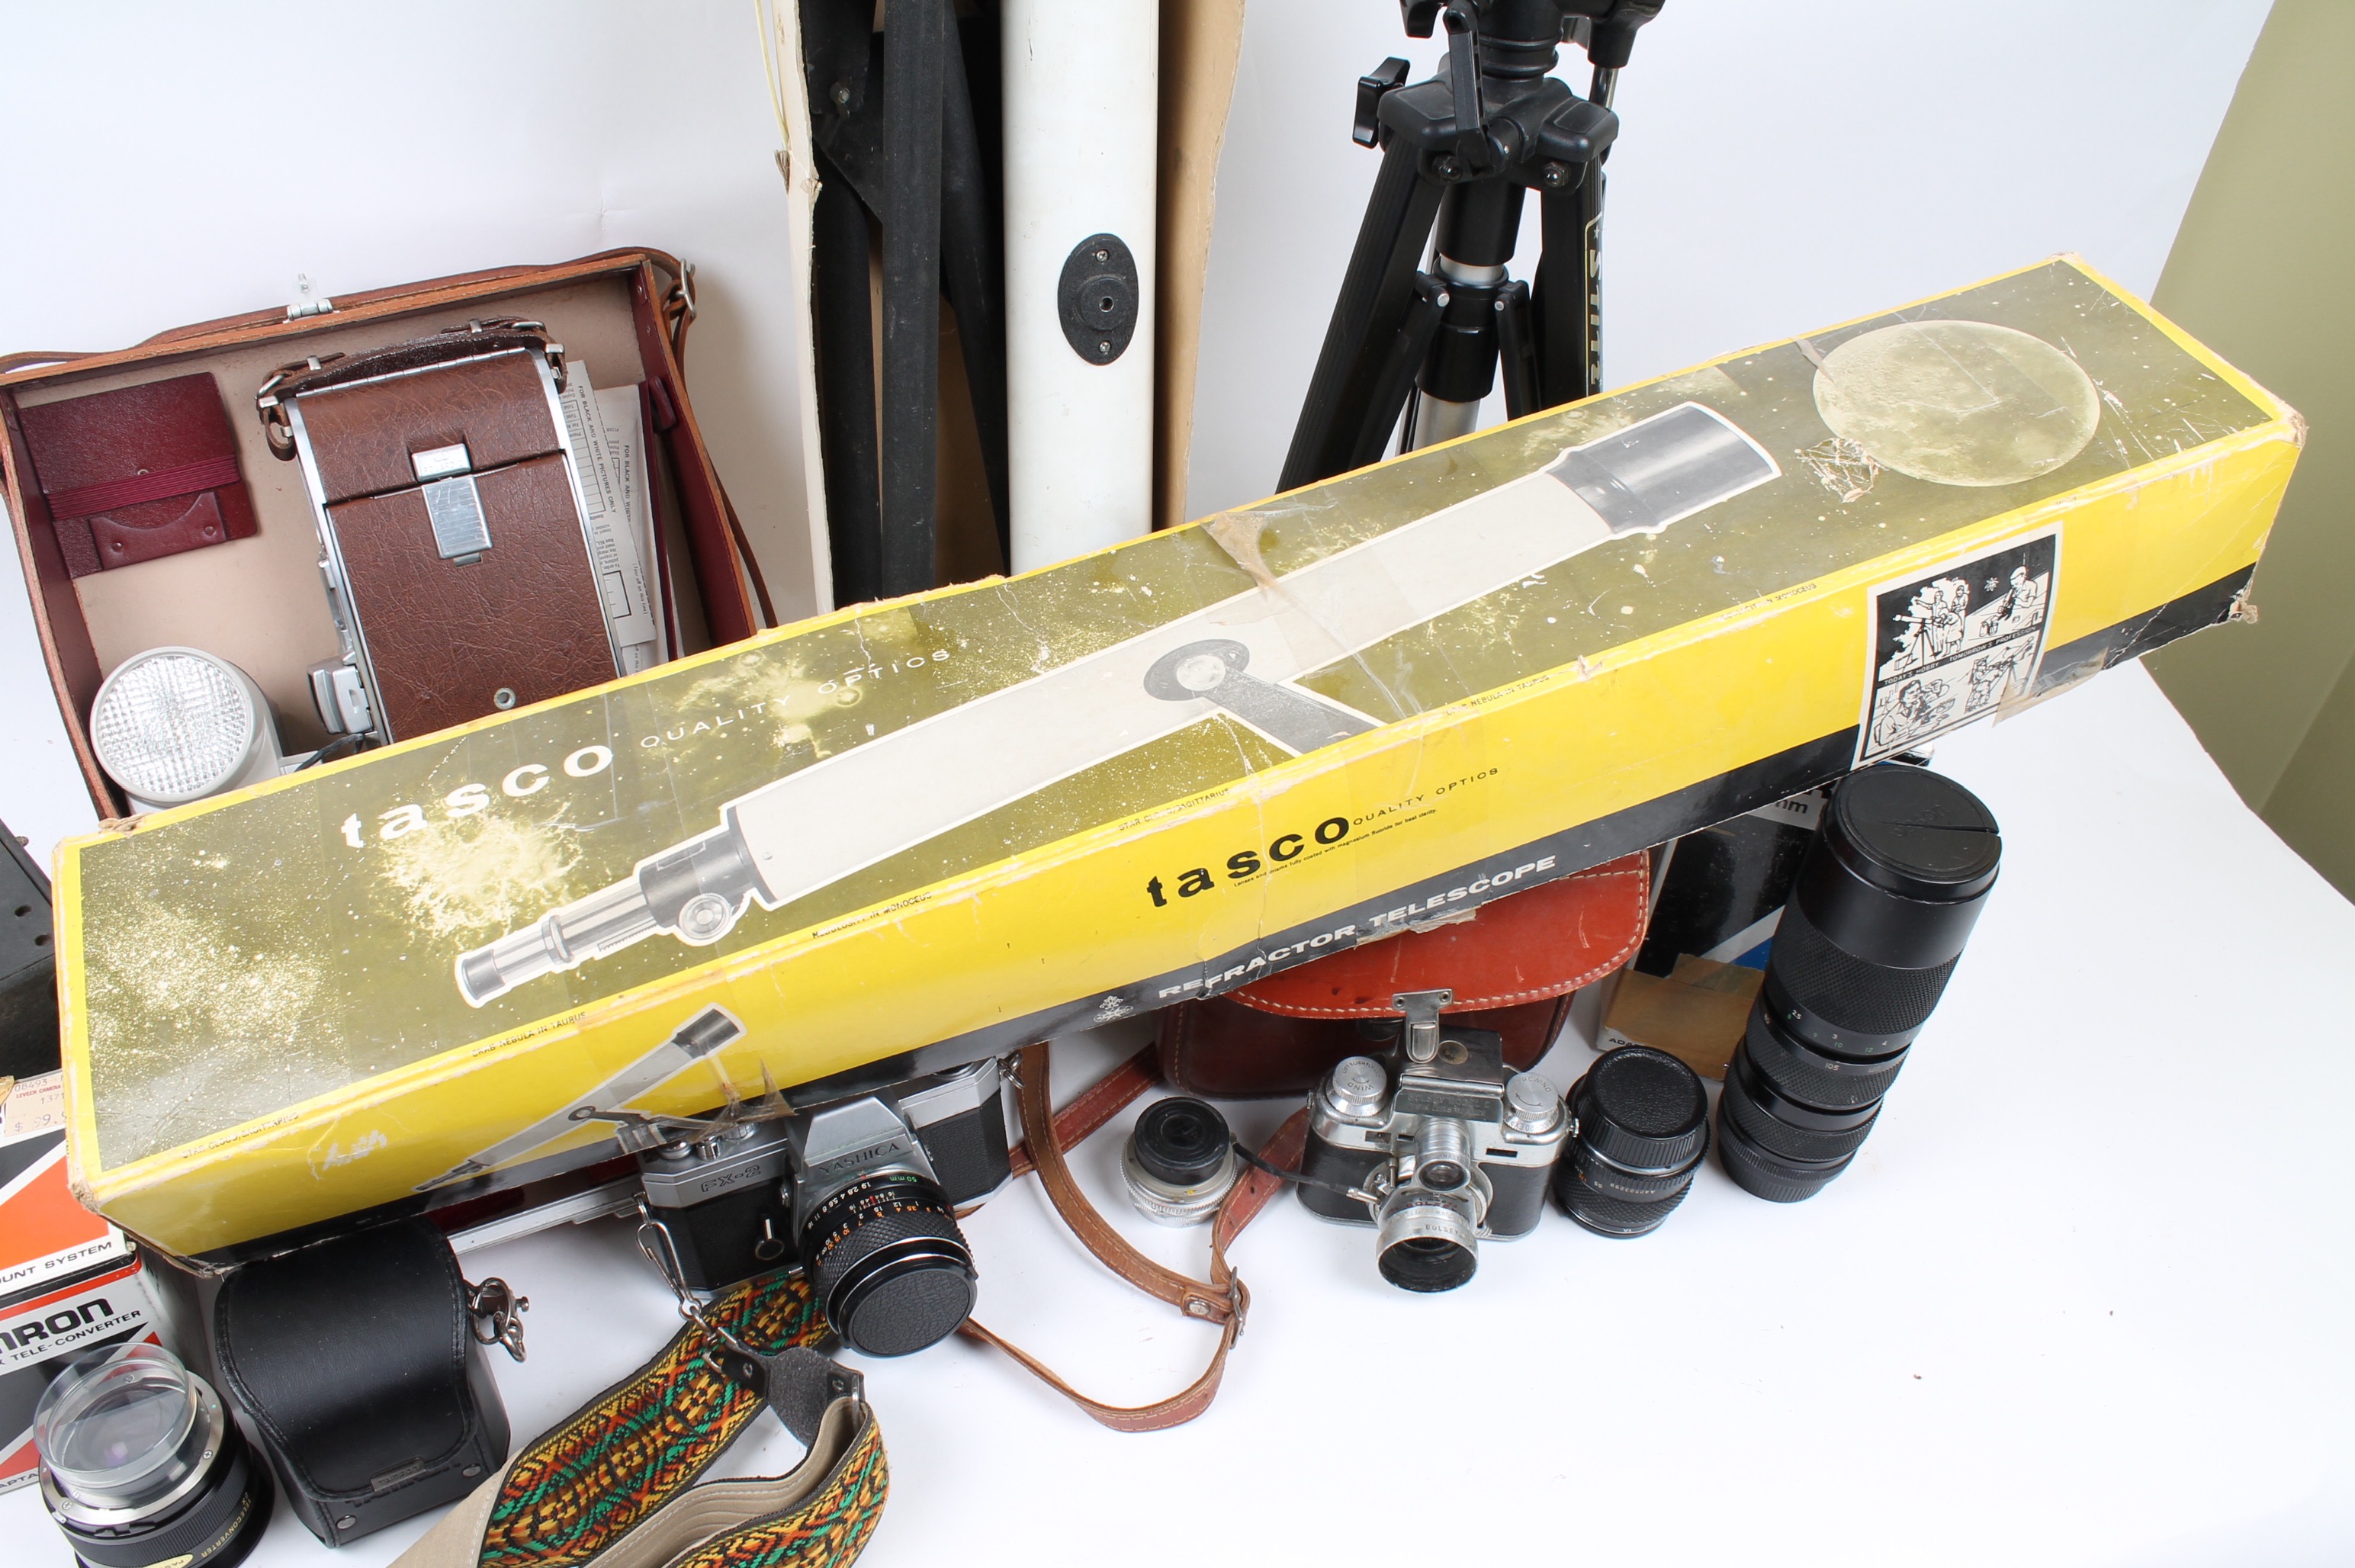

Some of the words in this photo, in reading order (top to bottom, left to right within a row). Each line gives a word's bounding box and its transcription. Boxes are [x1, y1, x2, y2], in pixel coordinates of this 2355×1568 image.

[583, 400, 592, 422] BLACK
[593, 441, 602, 461] WHITE
[599, 463, 612, 495] PICTURES
[608, 496, 617, 513] ONLY
[1884, 671, 1913, 686] TODAY'S
[1916, 661, 1940, 674] HOBBY
[1949, 640, 1994, 663] TOMORROW'S
[1995, 625, 2036, 645] PROFESSION
[640, 694, 791, 750] QUALITY
[818, 649, 950, 696] OPTICS
[1470, 692, 1503, 707] NEBULA
[1516, 674, 1550, 690] TAURUS
[340, 744, 613, 849] tasco
[1353, 794, 1425, 826] QUALITY
[1435, 767, 1499, 795] OPTICS
[1146, 816, 1350, 908] tasco
[1233, 876, 1255, 888] Lenses
[1289, 858, 1302, 867] fully
[1303, 850, 1323, 862] coated
[1324, 845, 1336, 853] with
[1337, 832, 1370, 849] magnesium
[1371, 824, 1393, 836] fluoride
[1405, 815, 1418, 824] best
[1158, 924, 1357, 999] REFRACTOR
[1367, 855, 1557, 928] TELESCOPE
[499, 1030, 535, 1047] NEBULA
[538, 1025, 548, 1034] IN
[551, 1011, 586, 1030] TAURUS
[1521, 1076, 1552, 1093] REWIND
[1824, 1062, 1840, 1072] 105
[14, 1078, 48, 1093] 08493
[16, 1089, 38, 1100] LEVECK
[39, 1084, 62, 1094] CAMERA
[1347, 1081, 1375, 1092] WIND
[14, 1121, 24, 1133] $
[819, 1142, 901, 1176] YASHICA
[700, 1164, 762, 1194] FX-2
[44, 1241, 112, 1270] SYSTEM
[10, 1309, 142, 1362] TELE-CONVERTER
